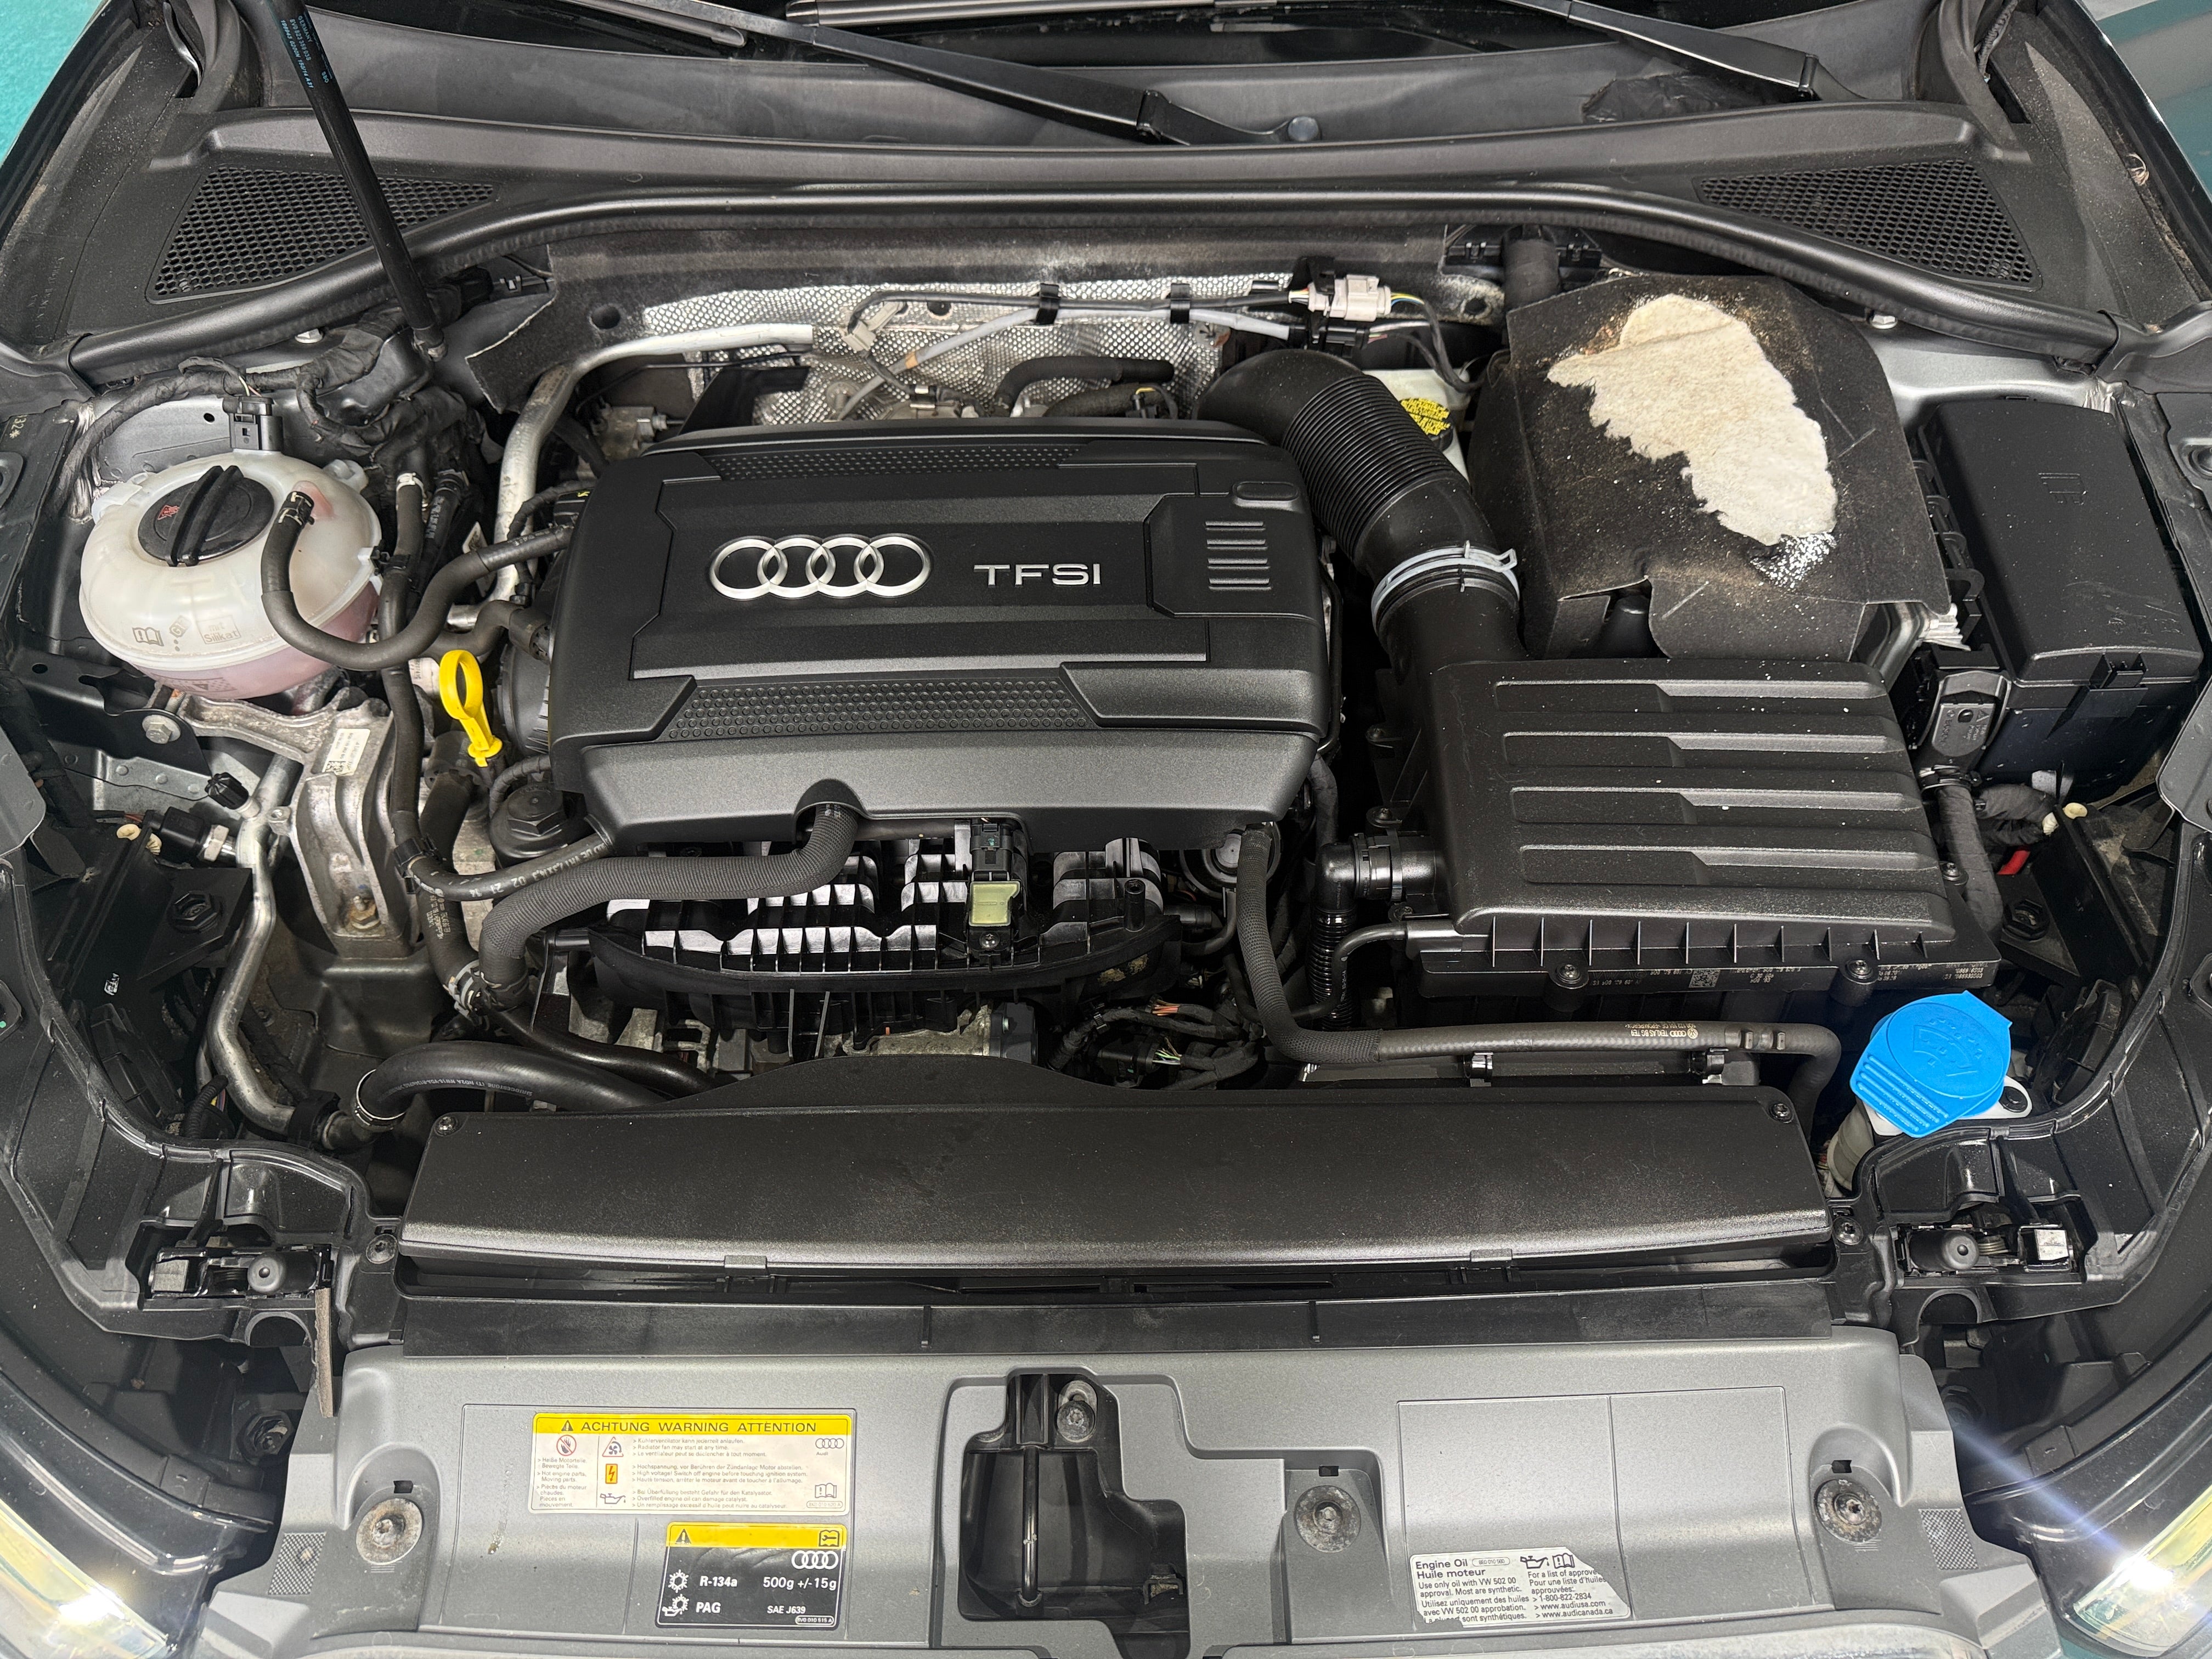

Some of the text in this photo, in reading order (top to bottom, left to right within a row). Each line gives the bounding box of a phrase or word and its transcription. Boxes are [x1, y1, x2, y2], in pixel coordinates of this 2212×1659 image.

[298, 15, 313, 42] GERMANY
[973, 563, 1101, 586] TFSI
[204, 630, 239, 643] Silikat
[511, 876, 527, 888] 02
[580, 1421, 816, 1432] ACHTUNG WARNING ATTENTION
[1415, 1559, 1468, 1570] Engine Oil
[1417, 1569, 1486, 1579] Huile moteur
[699, 1576, 794, 1590] R-134a 500g
[1434, 1581, 1449, 1589] only
[1420, 1589, 1453, 1598] approval.
[1488, 1585, 1522, 1595] synthetic.
[1421, 1600, 1448, 1608] Utilisez
[1450, 1598, 1492, 1607] uniquement
[1539, 1593, 1592, 1602] 1-800-822-2834
[696, 1602, 806, 1614] PAG SAE J639
[1441, 1607, 1454, 1615] VW
[1481, 1604, 1526, 1614] approbation.
[1541, 1601, 1606, 1609] www.audiusa.com
[1480, 1613, 1527, 1622] synthétiques.
[1542, 1608, 1613, 1618] www.audicanada.ca
